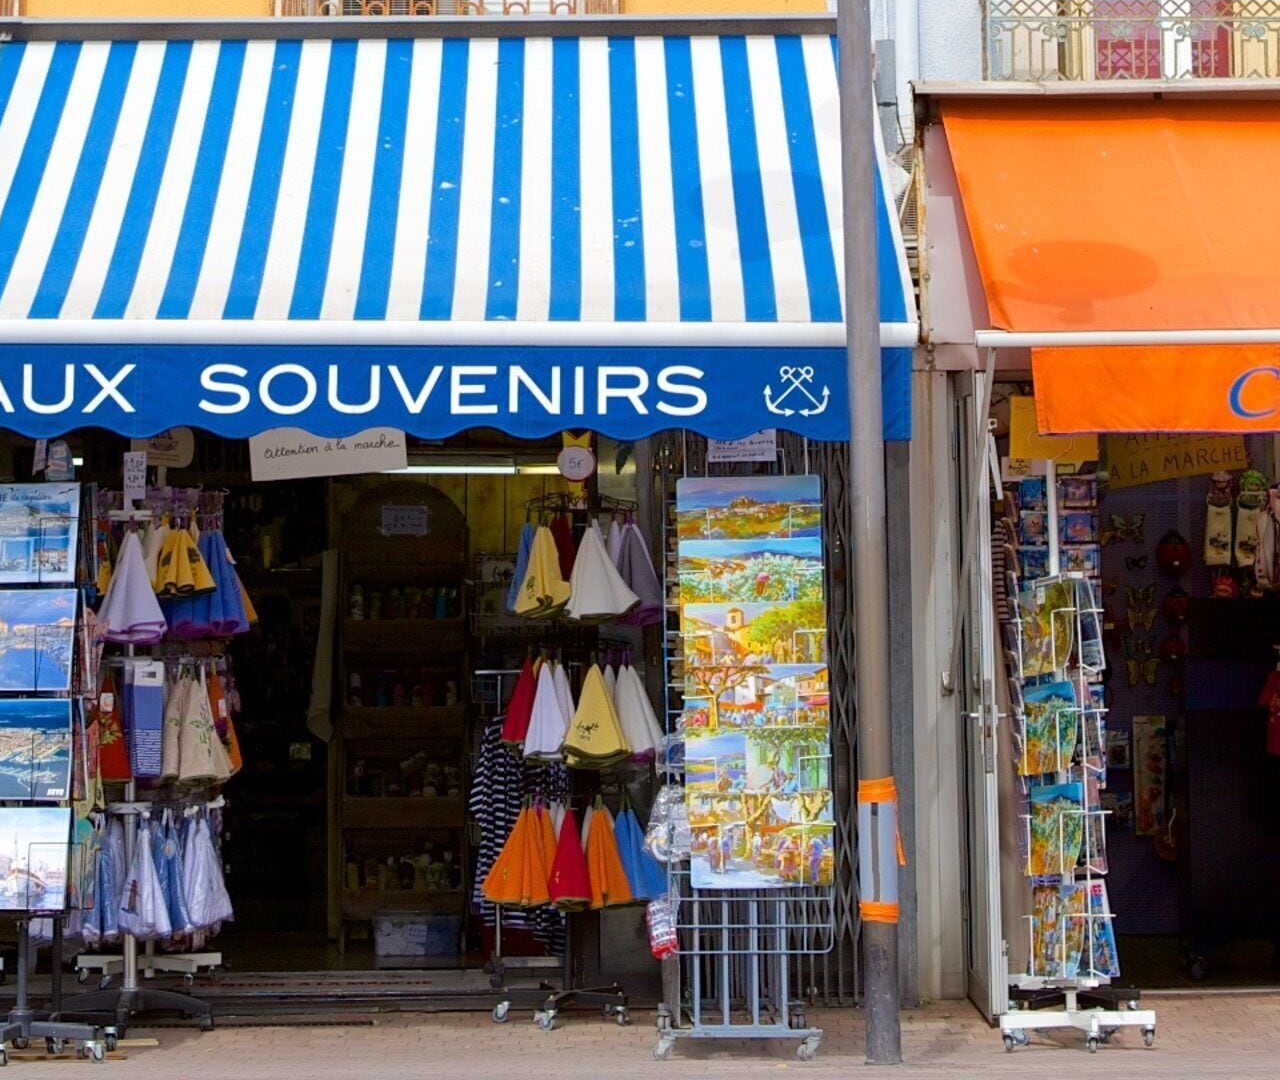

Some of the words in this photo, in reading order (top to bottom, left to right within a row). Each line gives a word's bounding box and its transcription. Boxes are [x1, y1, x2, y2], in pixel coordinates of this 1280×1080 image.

[198, 363, 708, 416] SOUVENIRS
[1130, 460, 1149, 479] LA
[1163, 445, 1246, 472] MARCHE
